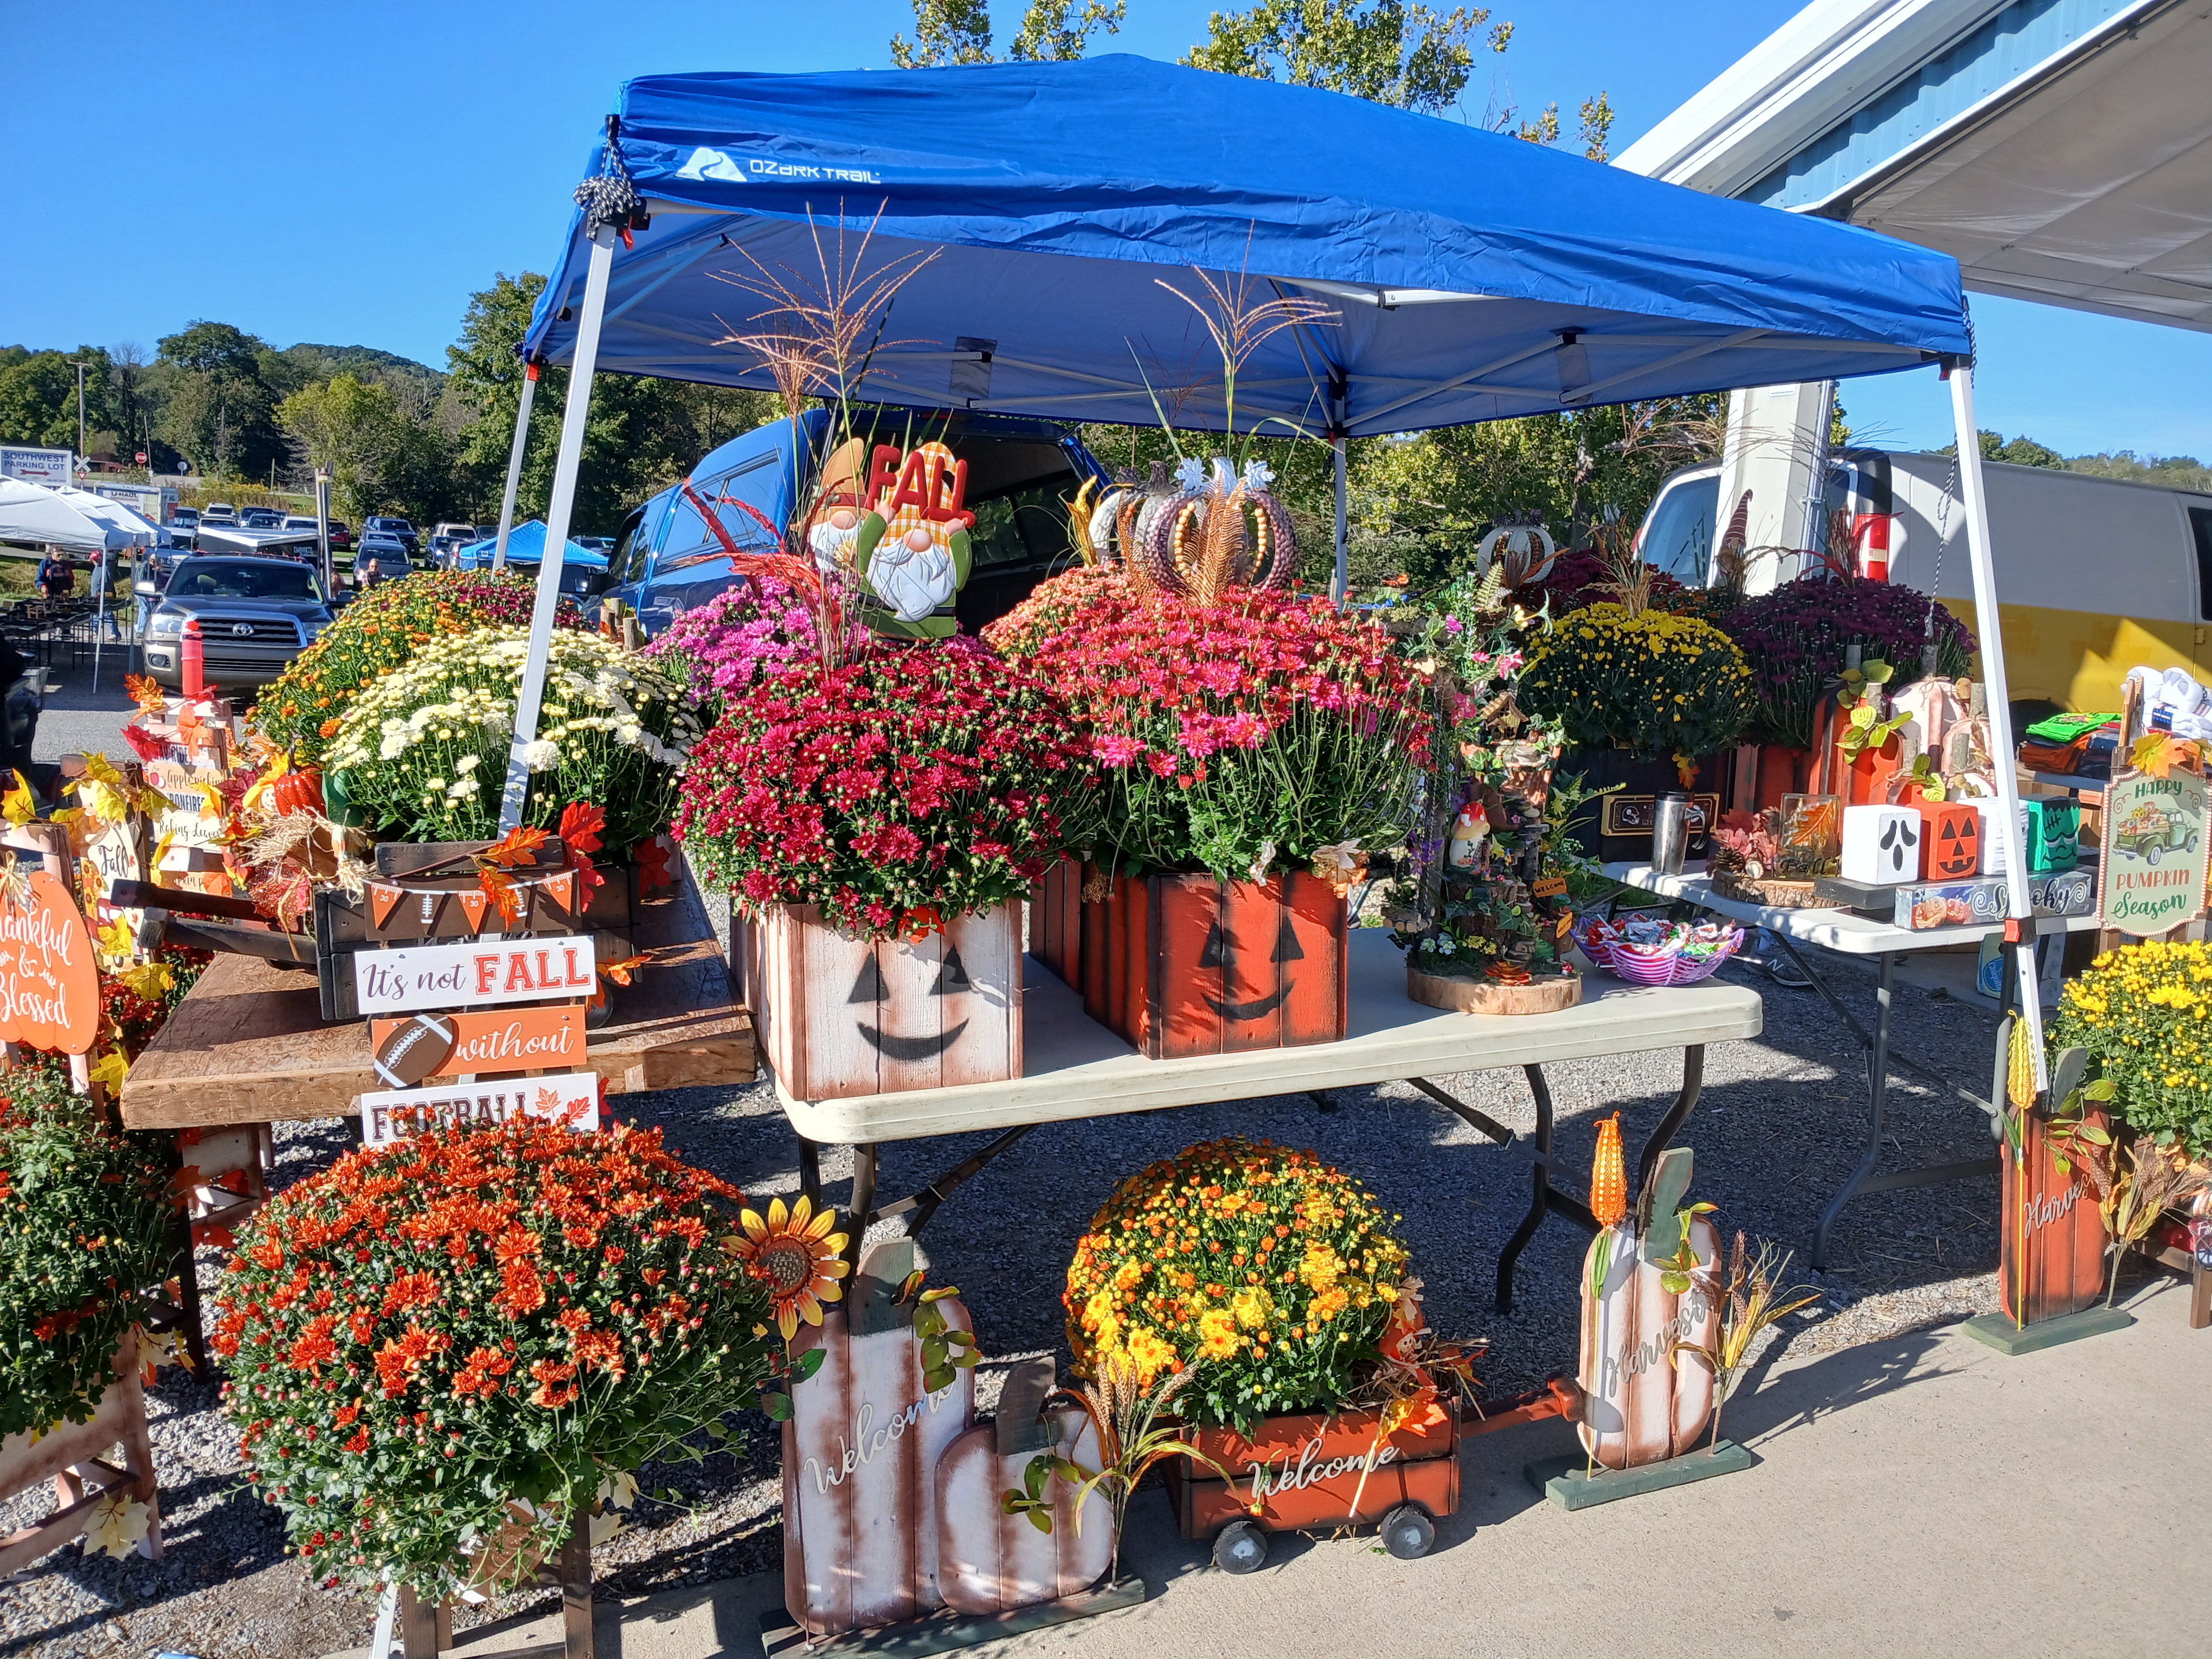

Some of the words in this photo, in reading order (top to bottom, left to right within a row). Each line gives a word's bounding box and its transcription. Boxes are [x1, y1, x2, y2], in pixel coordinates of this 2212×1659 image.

[4, 452, 65, 462] SOUTHWEST
[5, 461, 44, 469] PARKING
[867, 445, 975, 526] FALL
[2135, 780, 2182, 799] HAPPY
[98, 844, 129, 878] Fall
[379, 894, 389, 903] 30
[1534, 879, 1565, 893] WELCOME
[2111, 891, 2187, 919] Season
[362, 962, 408, 1001] It's
[417, 963, 466, 991] not
[474, 947, 590, 995] FALL
[455, 1021, 574, 1062] without
[2023, 1173, 2091, 1239] Harves
[1604, 1287, 1707, 1398] Harvest
[1246, 1437, 1400, 1499] Welcome
